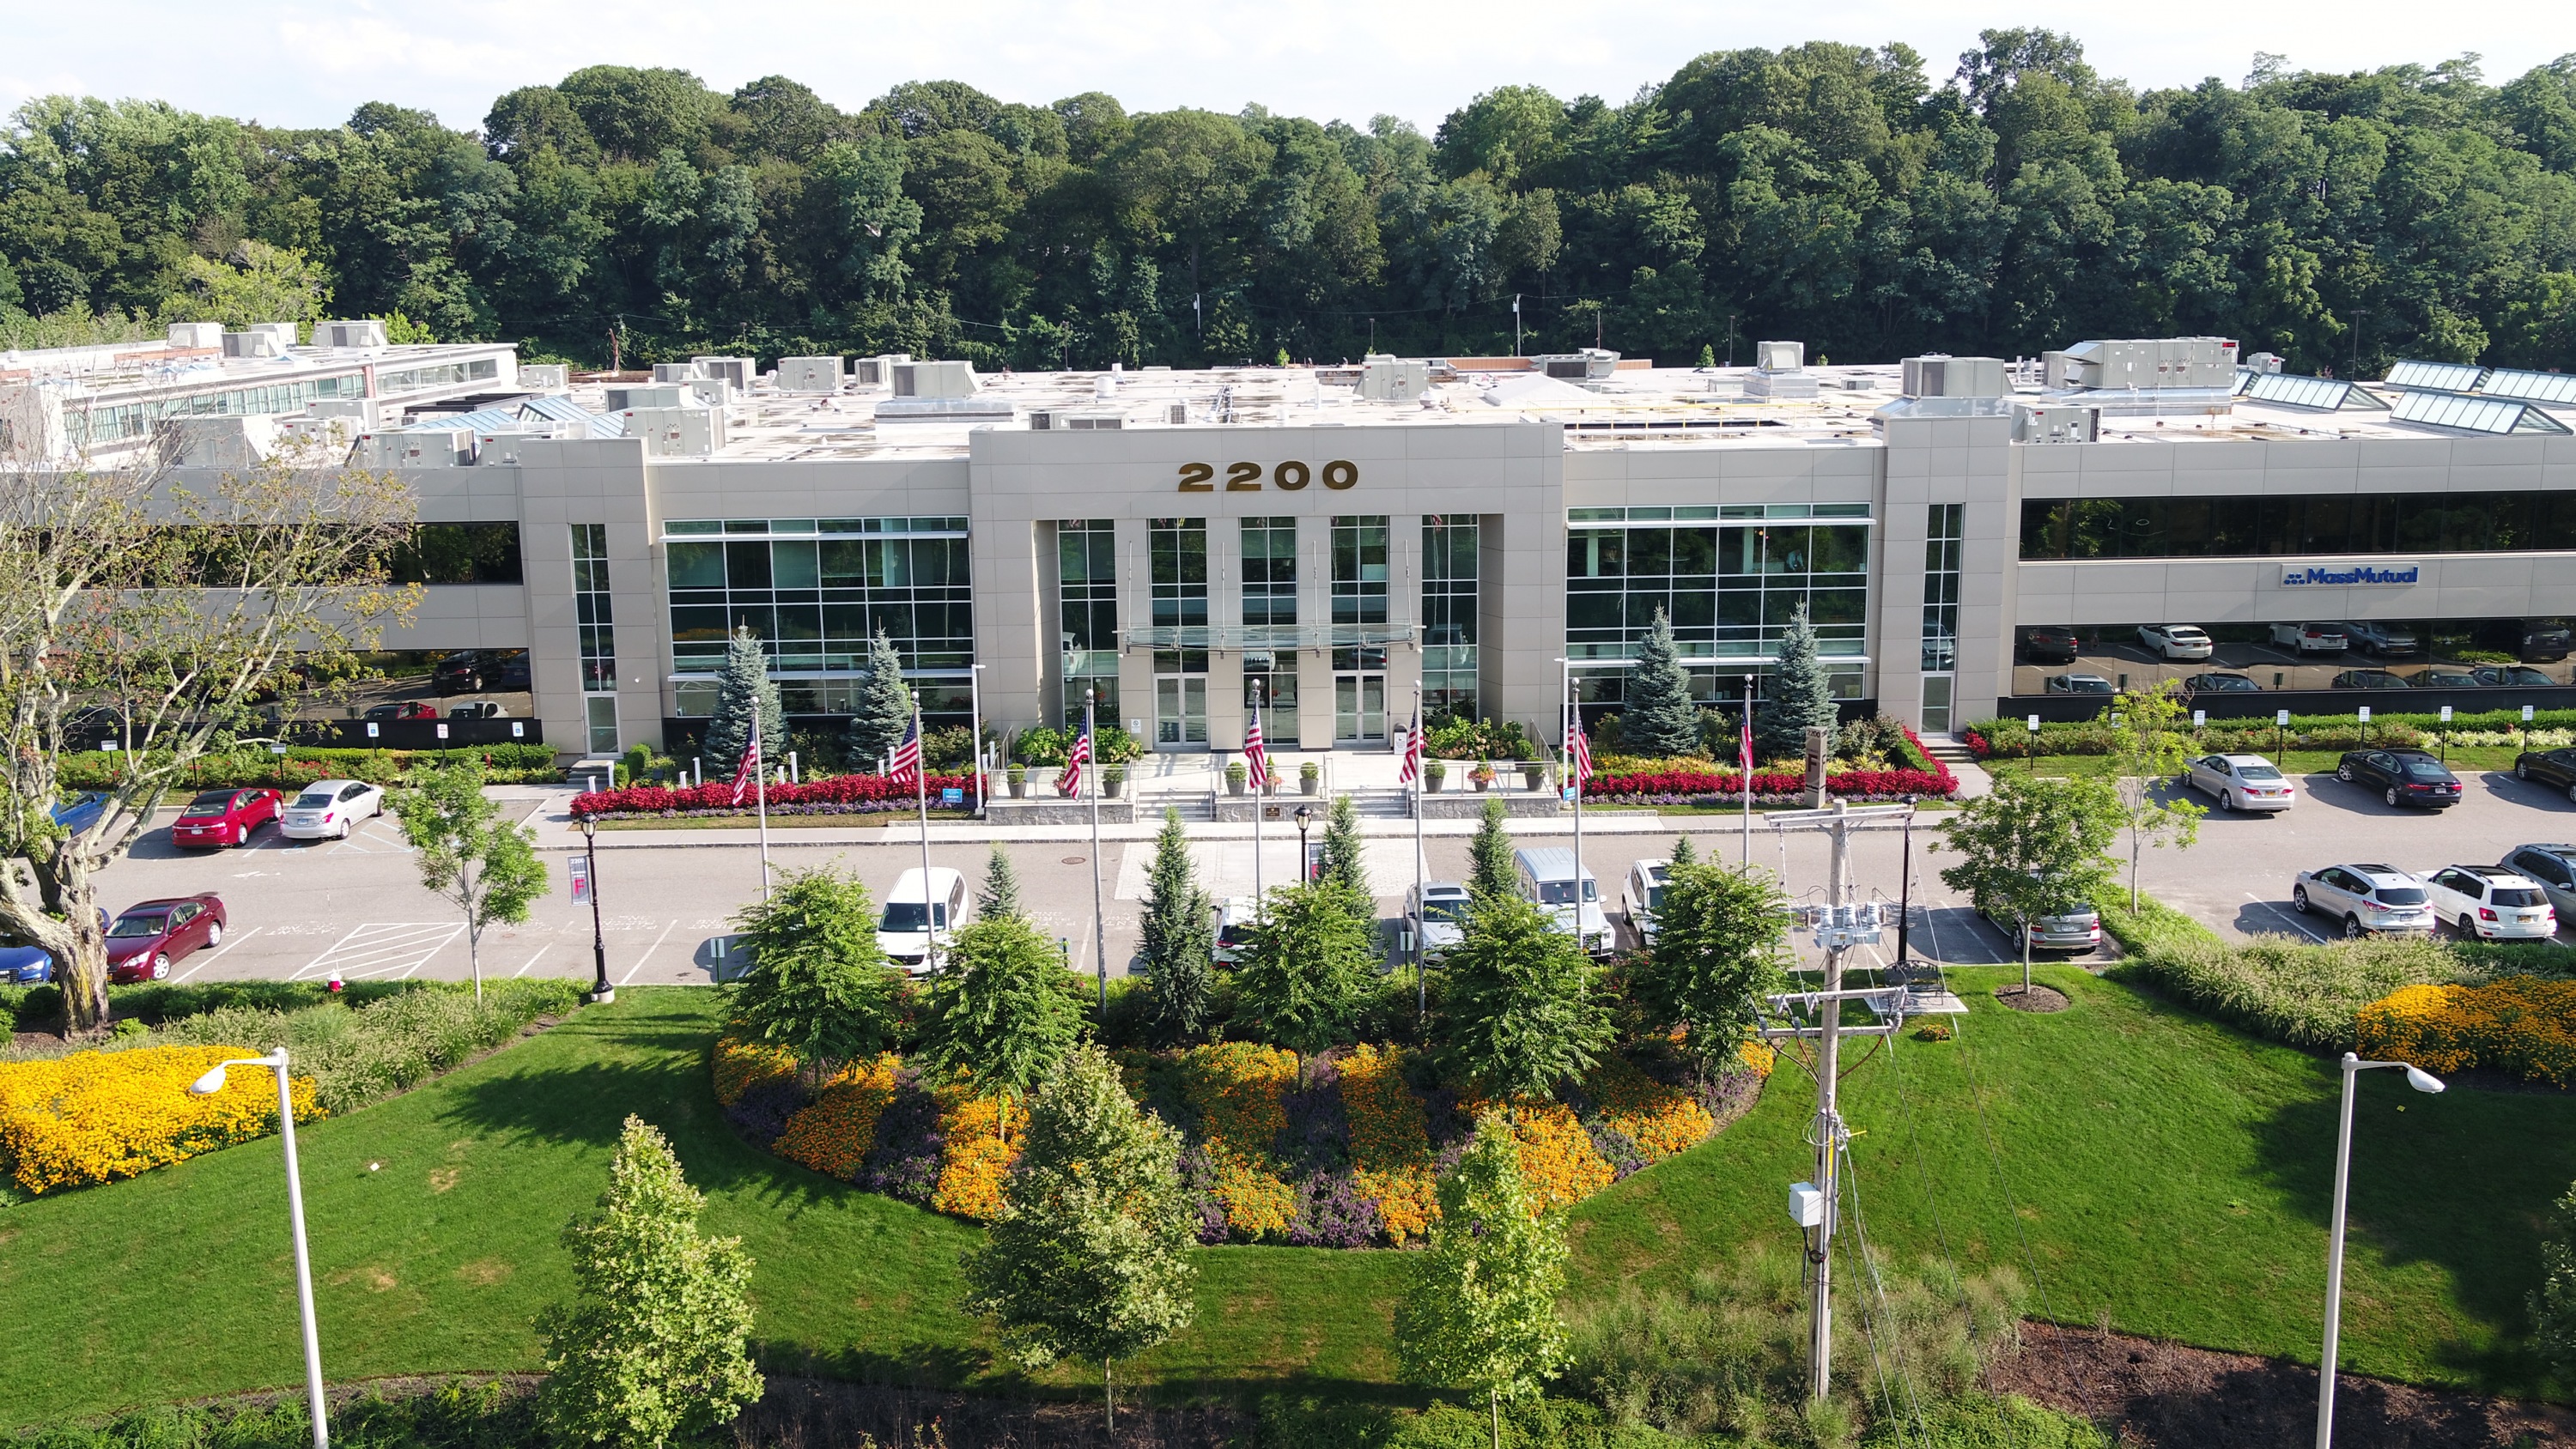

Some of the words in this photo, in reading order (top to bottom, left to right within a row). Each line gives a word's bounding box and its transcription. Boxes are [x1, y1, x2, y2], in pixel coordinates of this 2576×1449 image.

[1177, 460, 1358, 492] 2200
[2306, 567, 2418, 584] MassMutual
[1807, 730, 1820, 738] 2200
[1808, 754, 1818, 772] F
[574, 878, 586, 894] F
